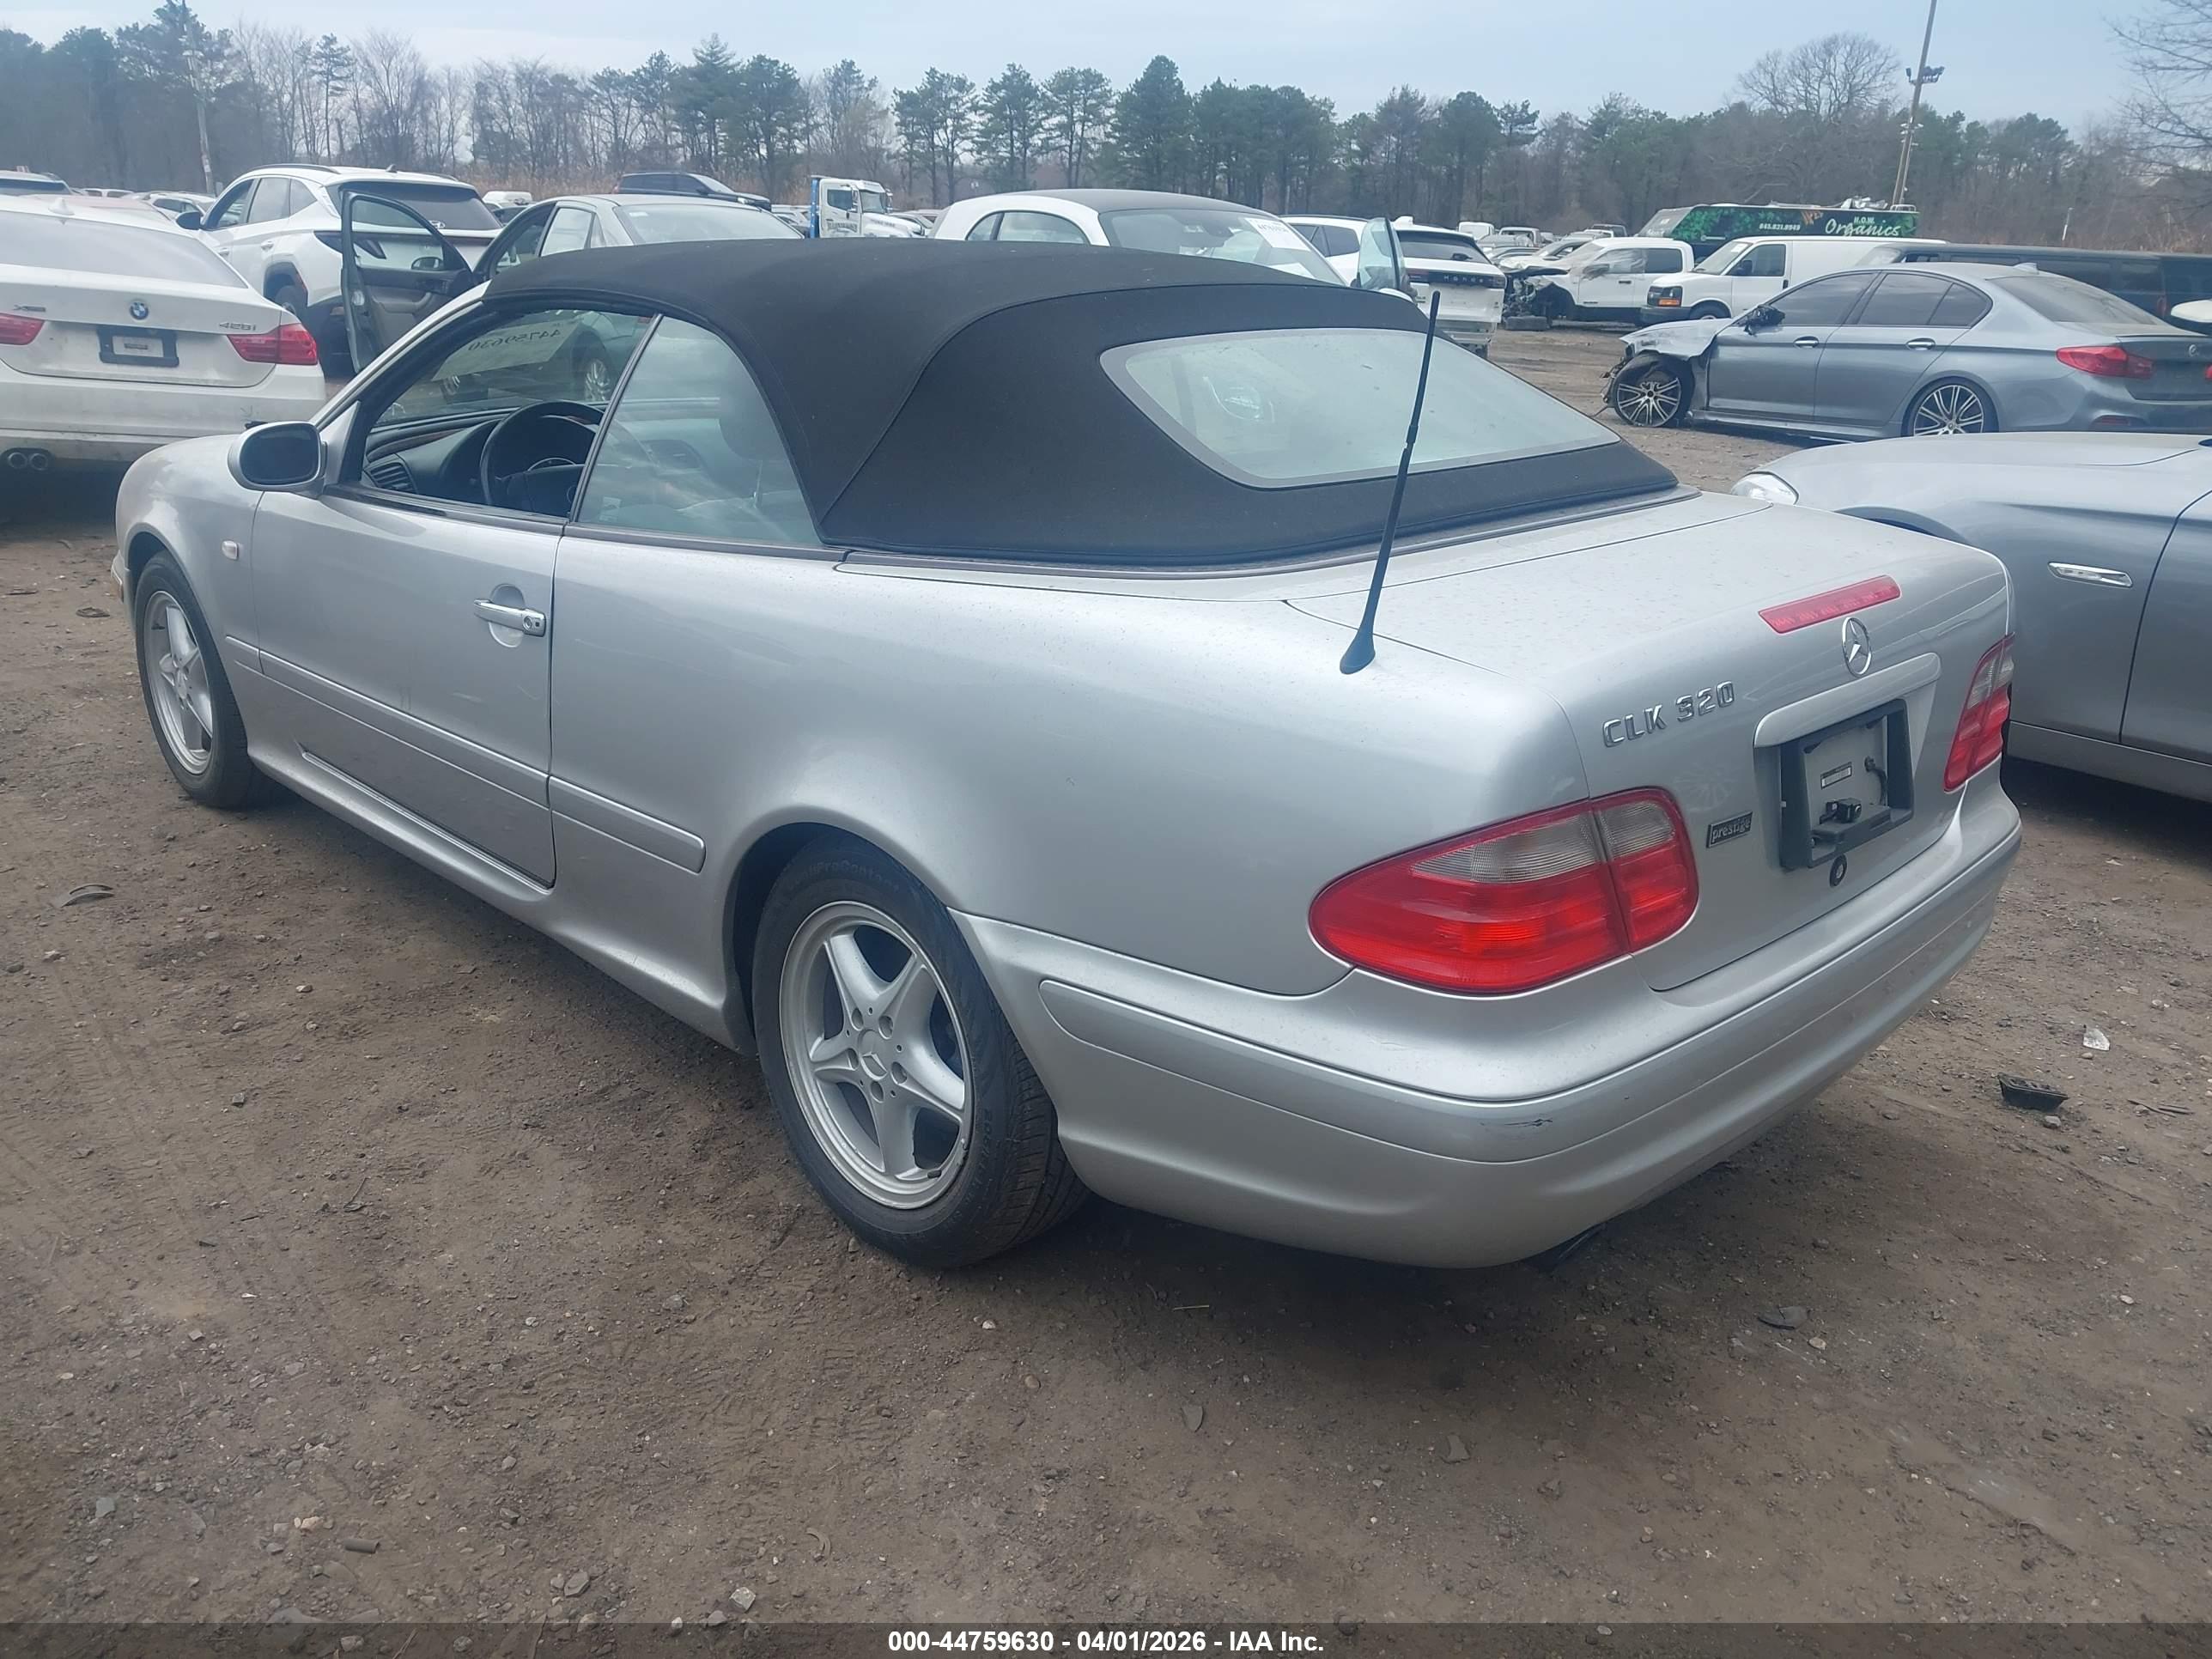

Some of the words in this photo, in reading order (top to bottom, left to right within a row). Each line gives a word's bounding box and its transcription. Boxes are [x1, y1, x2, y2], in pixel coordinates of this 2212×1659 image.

[1825, 218, 1902, 236] Organics
[219, 321, 257, 331] 428i
[1601, 703, 1668, 748] CLK
[1674, 679, 1735, 723] 320
[1711, 815, 1751, 843] prestige
